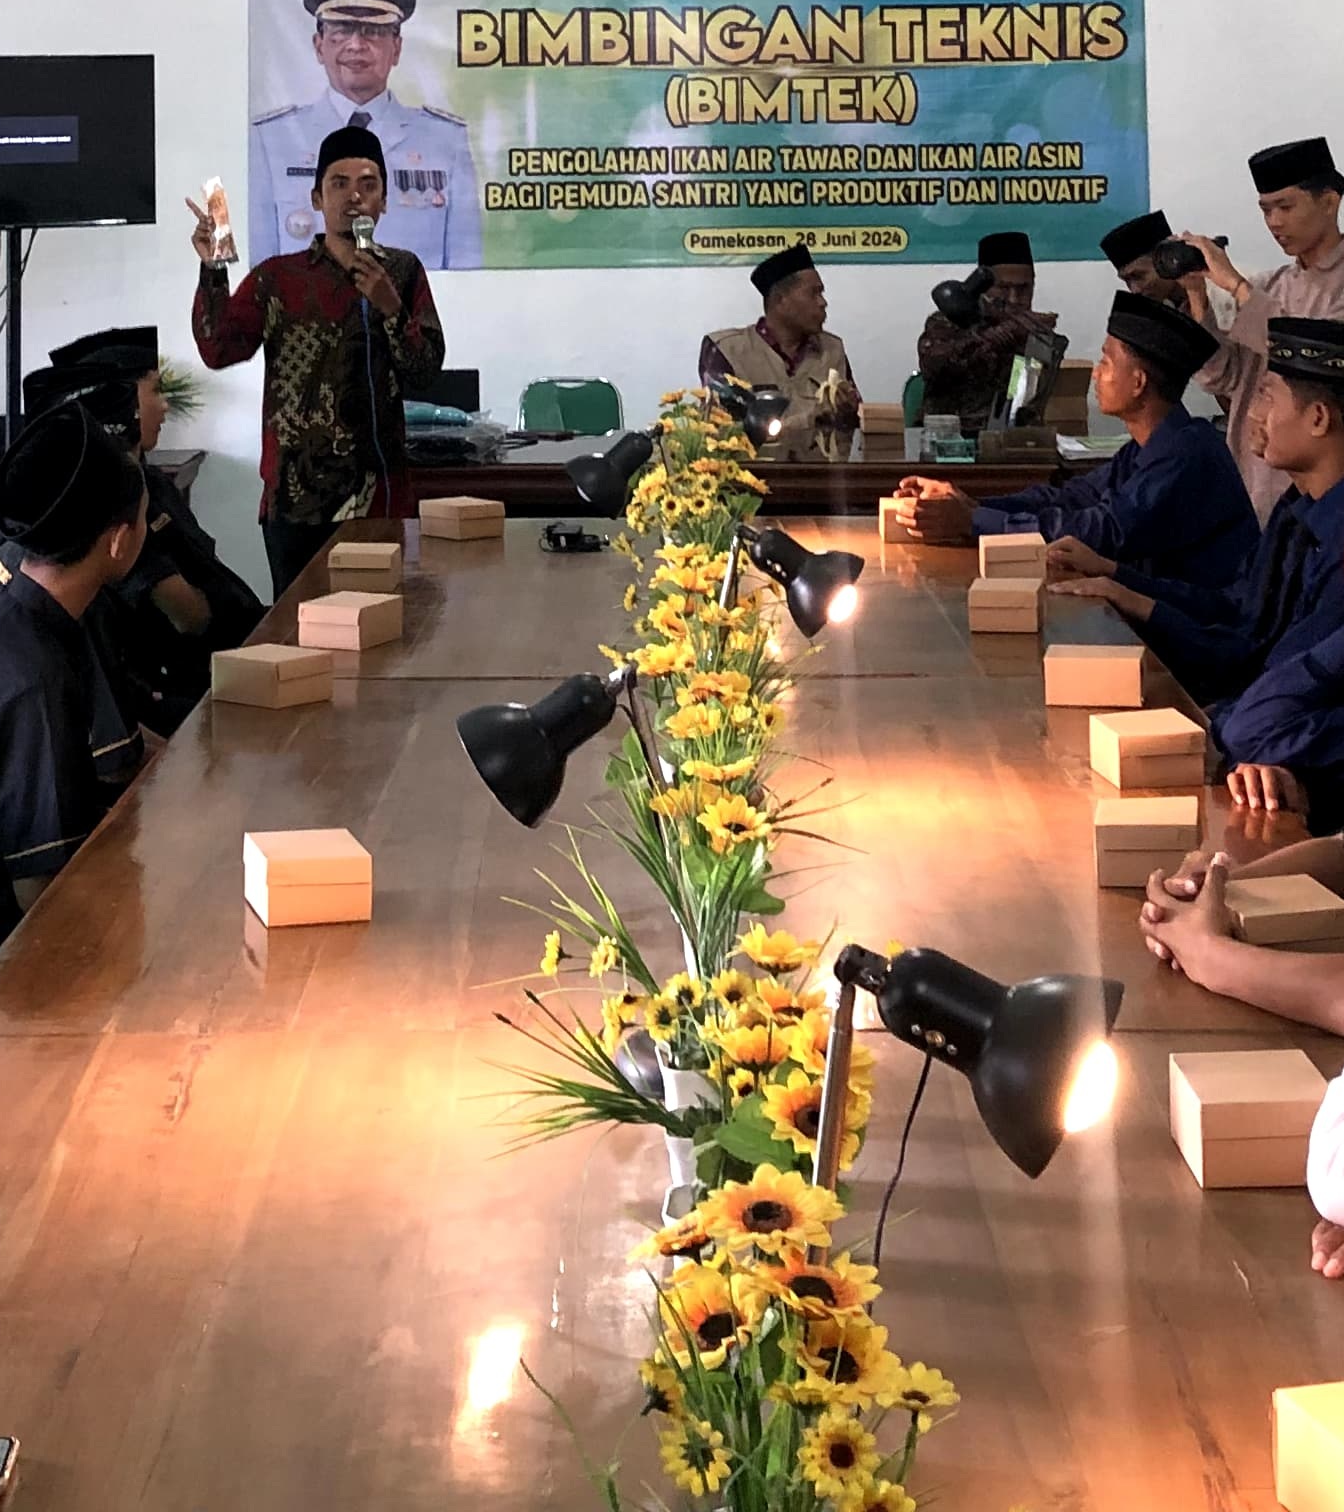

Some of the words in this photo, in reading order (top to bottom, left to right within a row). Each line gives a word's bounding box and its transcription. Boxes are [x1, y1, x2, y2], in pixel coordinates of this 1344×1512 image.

[457, 4, 865, 68] BIMBINGAN
[879, 1, 1129, 64] TEKNIS
[663, 72, 919, 128] (BIMTEK)
[509, 147, 667, 177] PENGOLAHAN
[672, 146, 730, 175] IKAN
[733, 146, 774, 174] AIR
[778, 145, 861, 173] TAWAR
[864, 144, 914, 172] DAN
[918, 144, 977, 172] IKAN
[979, 143, 1022, 171] AIR
[1024, 142, 1084, 170] ASIN
[485, 182, 544, 210] BAGI
[546, 181, 652, 210] PEMUDA
[652, 180, 739, 209] SANTRI
[743, 179, 807, 208] YANG
[810, 178, 945, 207] PRODUKTIF
[946, 177, 1001, 206] DAN
[1002, 176, 1108, 206] INOVATIF
[689, 232, 792, 249] Pamekasan,
[796, 232, 817, 247] 28
[822, 231, 856, 248] Juni
[861, 231, 902, 247] 2024
